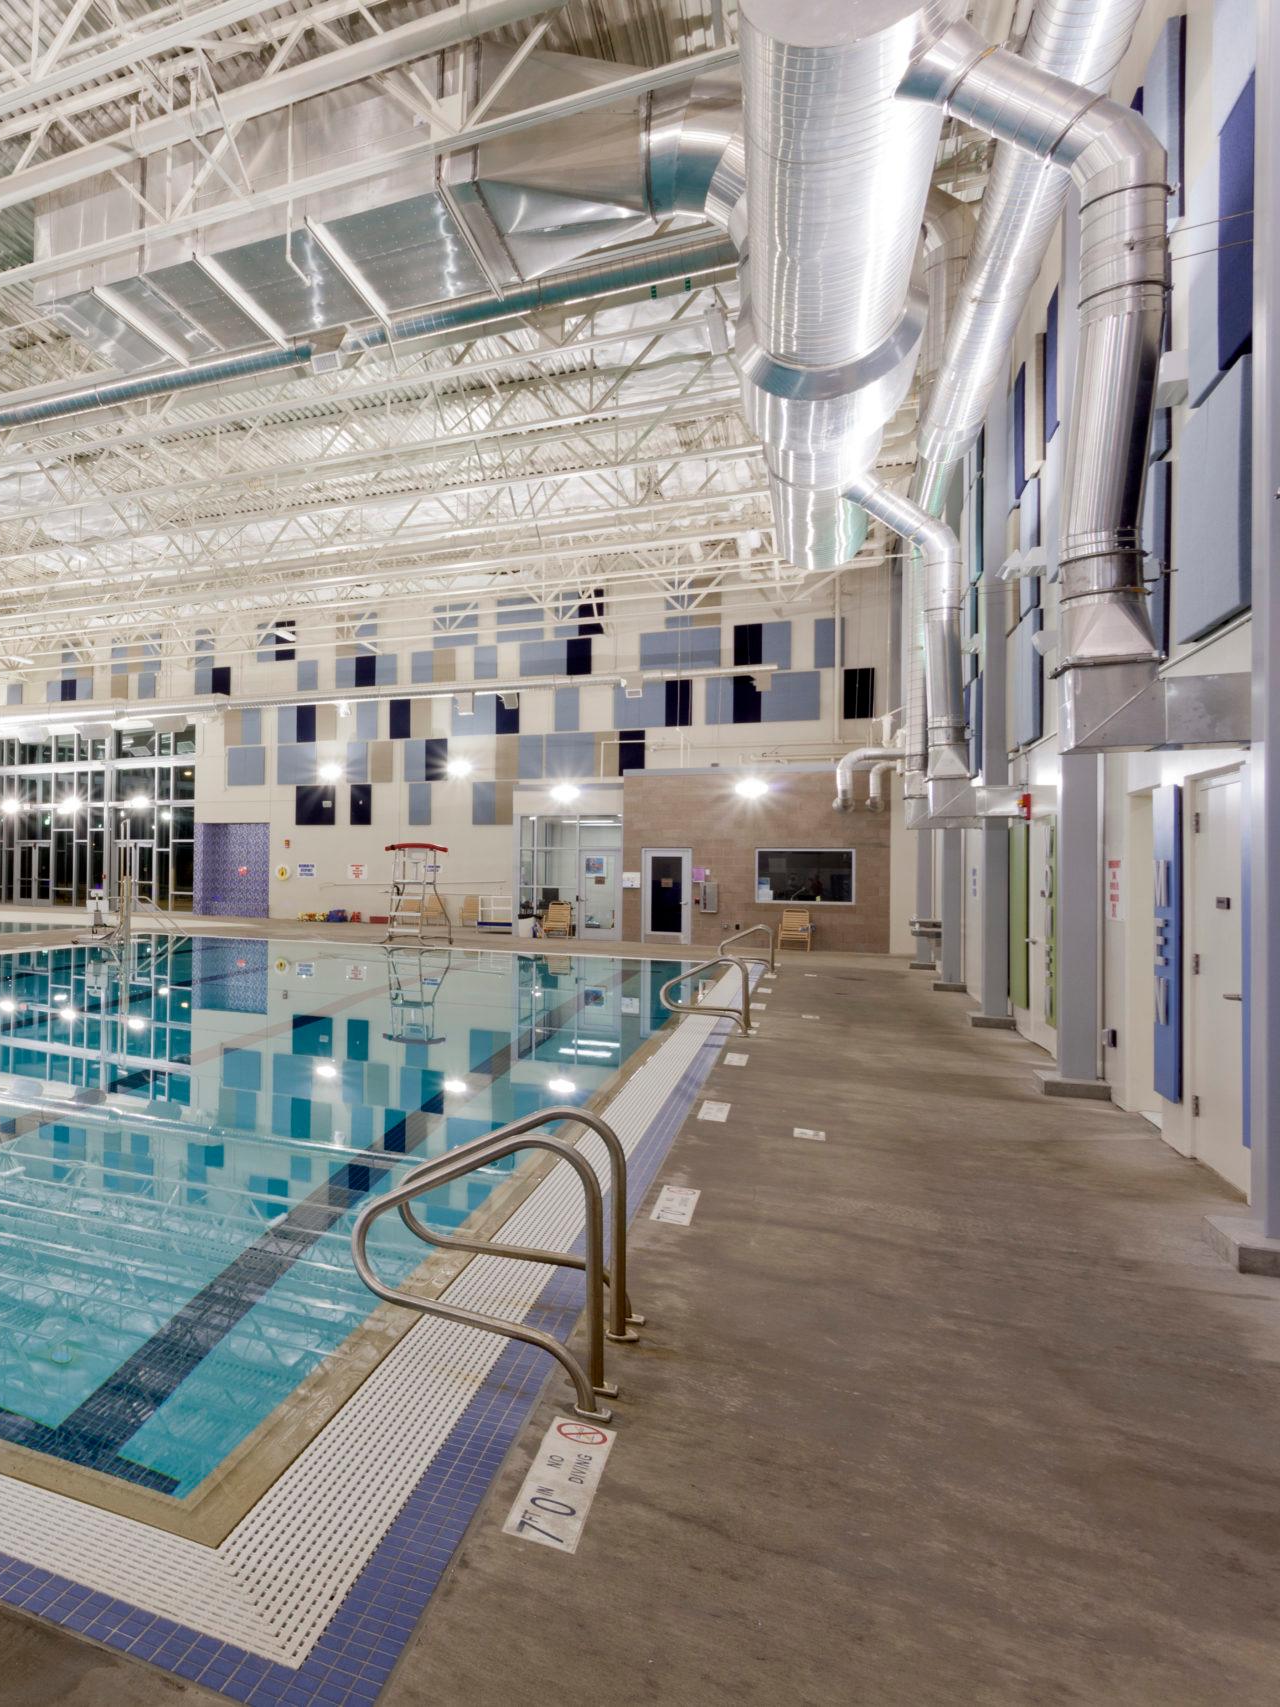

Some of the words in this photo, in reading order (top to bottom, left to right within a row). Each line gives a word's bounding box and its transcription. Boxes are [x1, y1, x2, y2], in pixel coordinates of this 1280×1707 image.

[1152, 859, 1167, 1025] MEN
[546, 1454, 565, 1469] NO
[568, 1453, 593, 1485] DIVING
